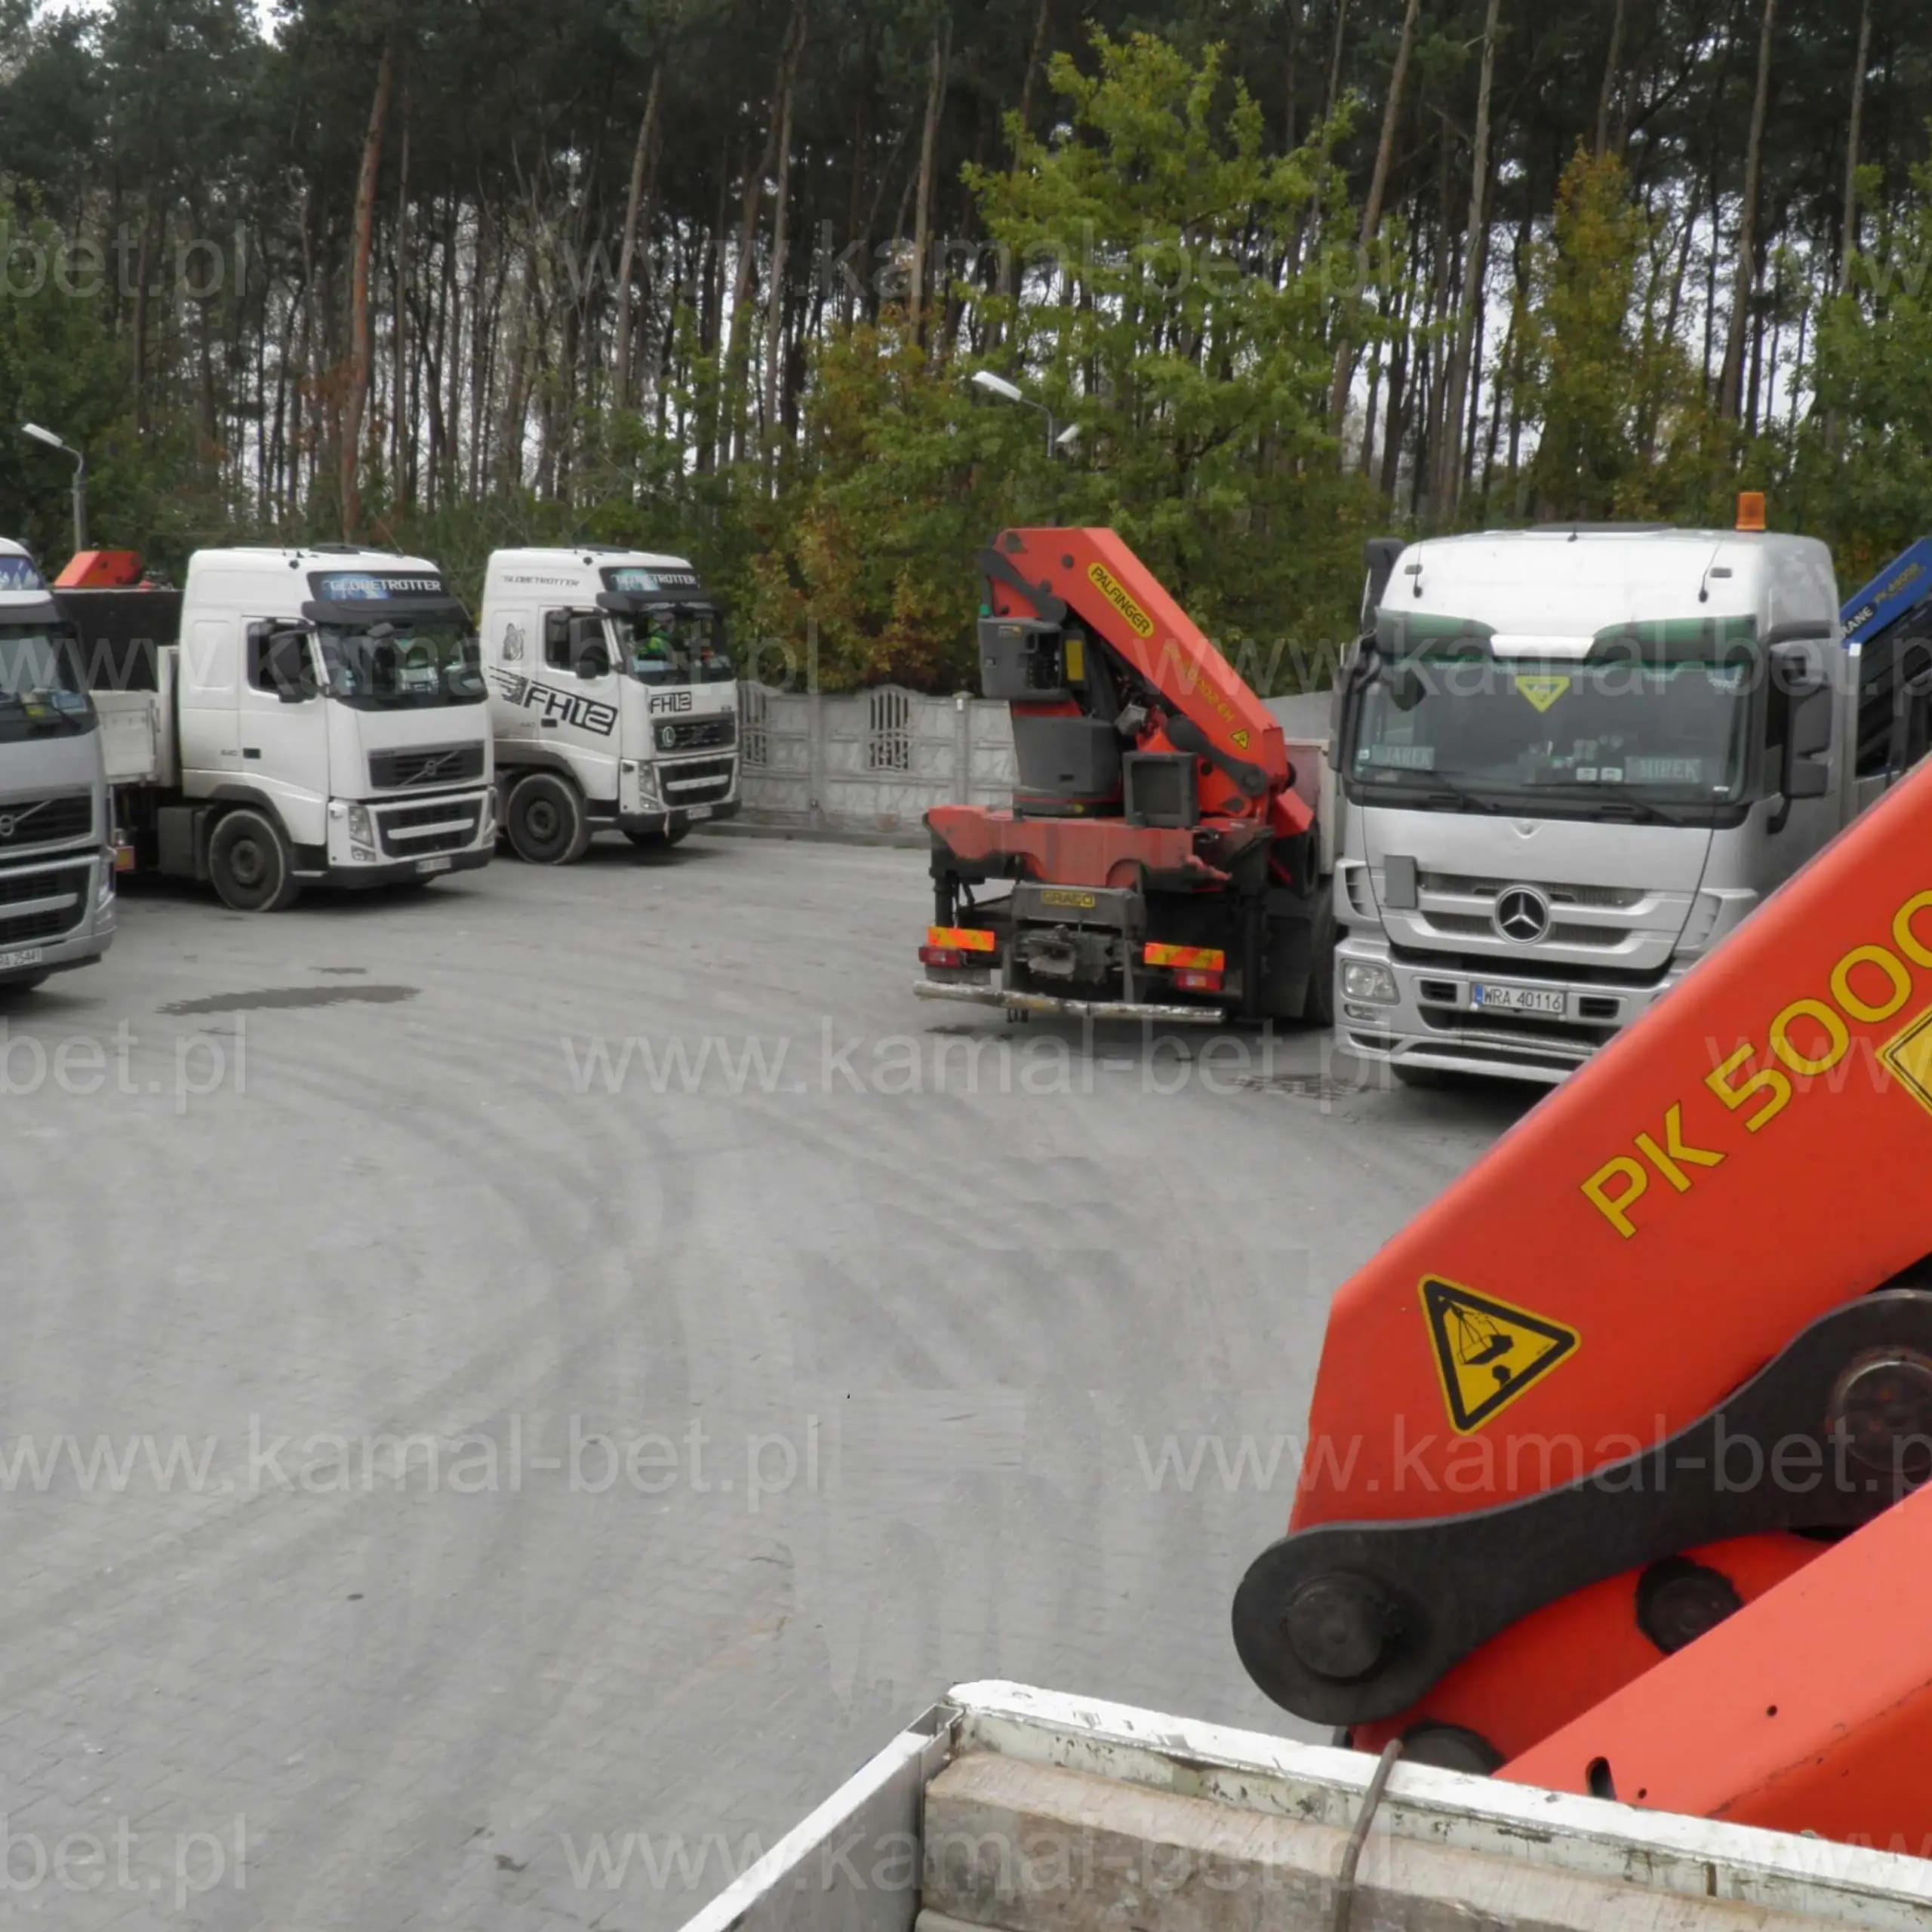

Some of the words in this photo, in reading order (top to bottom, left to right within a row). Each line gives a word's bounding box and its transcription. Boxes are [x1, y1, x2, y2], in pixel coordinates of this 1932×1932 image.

[1091, 566, 1151, 634] PALFINGER
[523, 683, 617, 737] FH12
[1484, 987, 1511, 1004] WRA
[1516, 991, 1561, 1011] 40116
[1579, 1099, 1729, 1240] PK
